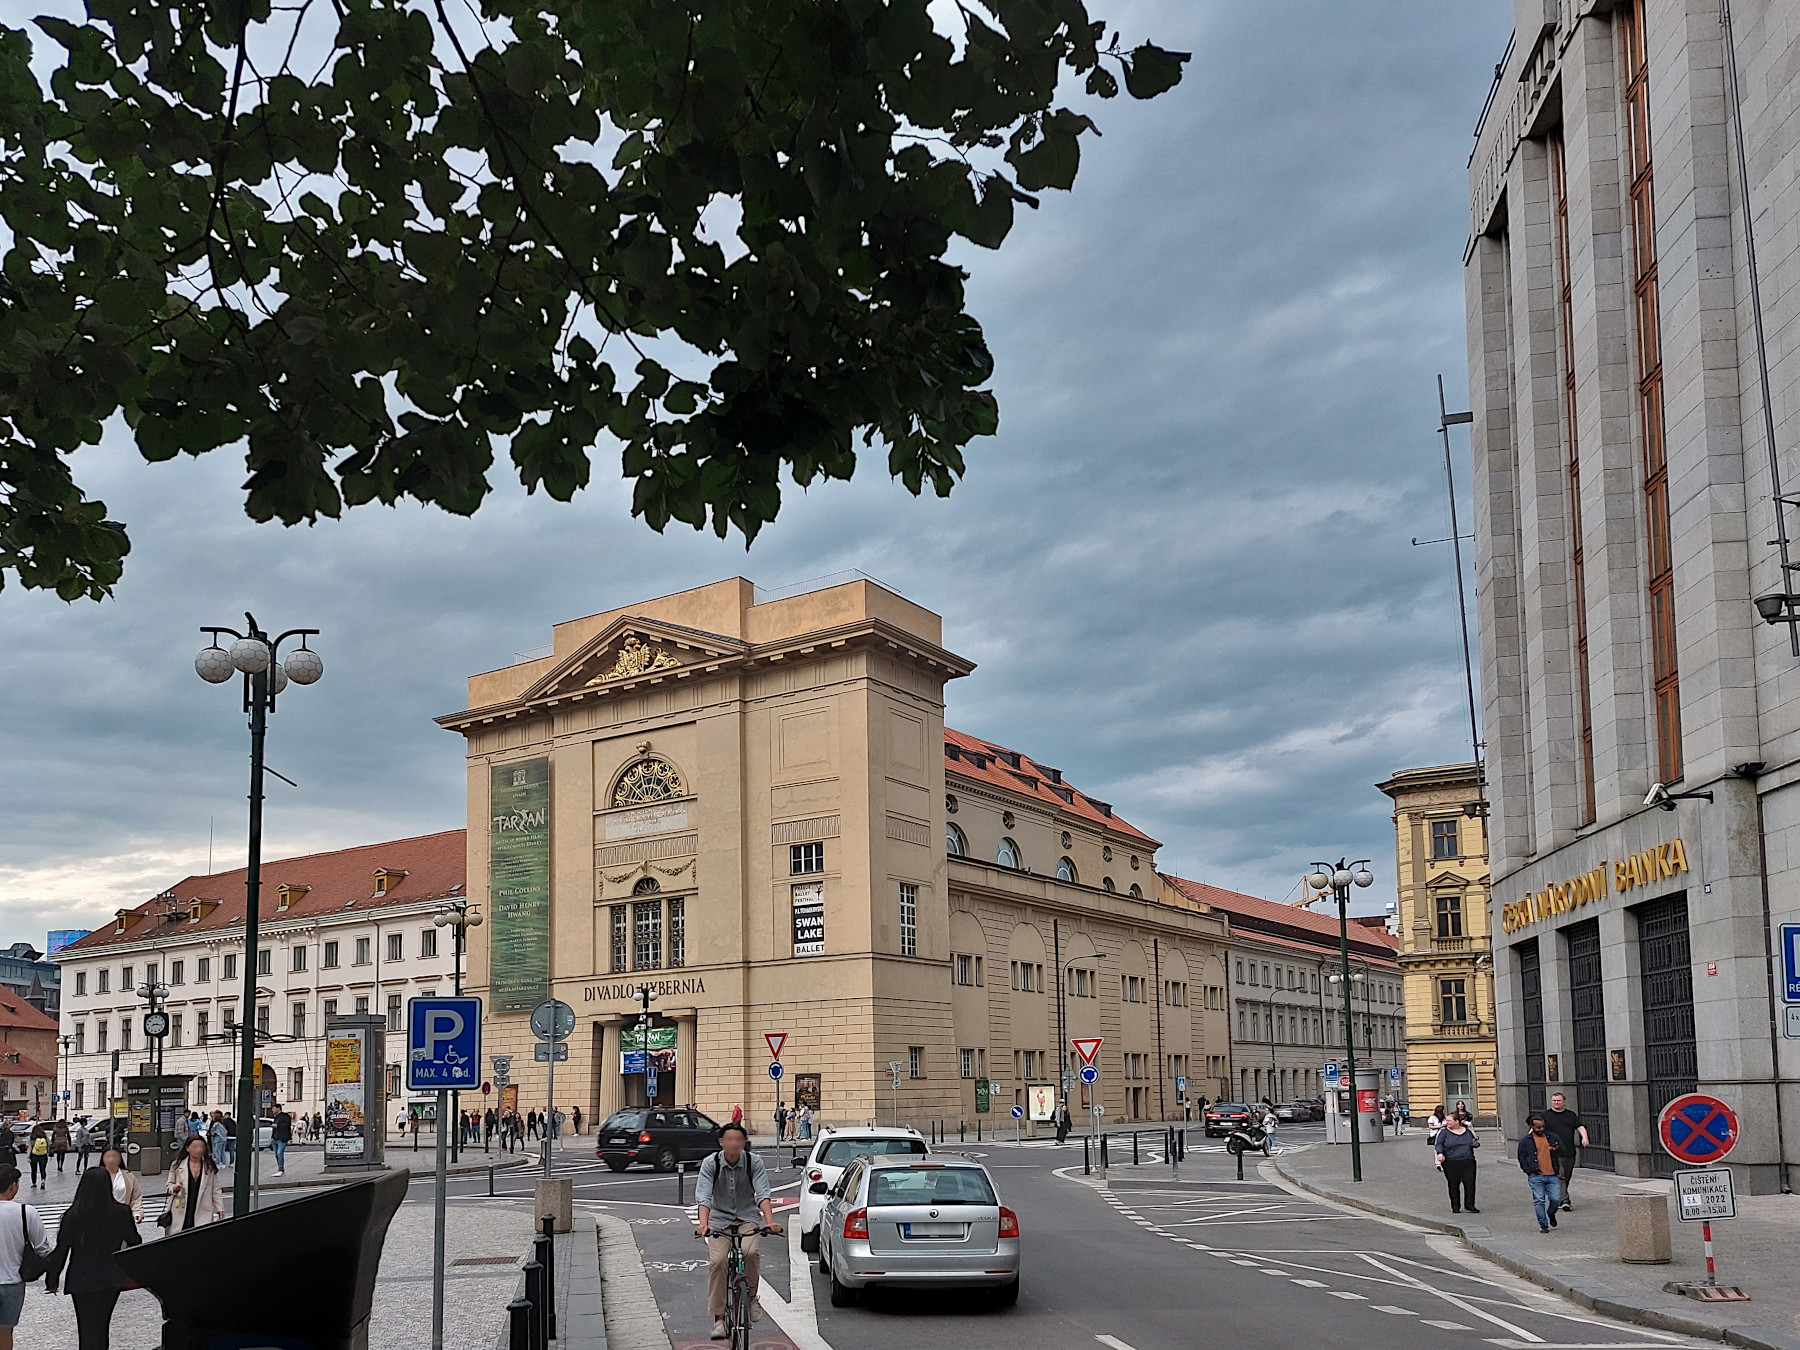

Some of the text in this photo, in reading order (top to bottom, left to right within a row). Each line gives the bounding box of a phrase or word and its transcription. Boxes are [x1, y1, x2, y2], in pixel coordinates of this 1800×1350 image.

[493, 805, 546, 834] TARZAN
[1536, 860, 1607, 920] NÁRODNÍ
[1614, 838, 1688, 893] BANKA
[499, 886, 541, 897] PHIL COLLINS
[499, 901, 541, 912] DAVID HENRY
[507, 911, 531, 919] HWANG
[795, 916, 824, 928] SWAN
[797, 928, 823, 940] LAKE
[796, 944, 824, 954] BALLET
[584, 983, 634, 1001] DIVADLO
[425, 1009, 464, 1060] P
[634, 1032, 660, 1045] TAZAN
[415, 1067, 471, 1078] MAX. 4 d.
[1326, 1064, 1336, 1076] P
[1690, 1174, 1717, 1185] ČIŠTĚNÍ
[1682, 1185, 1728, 1195] KOMUNIKACE
